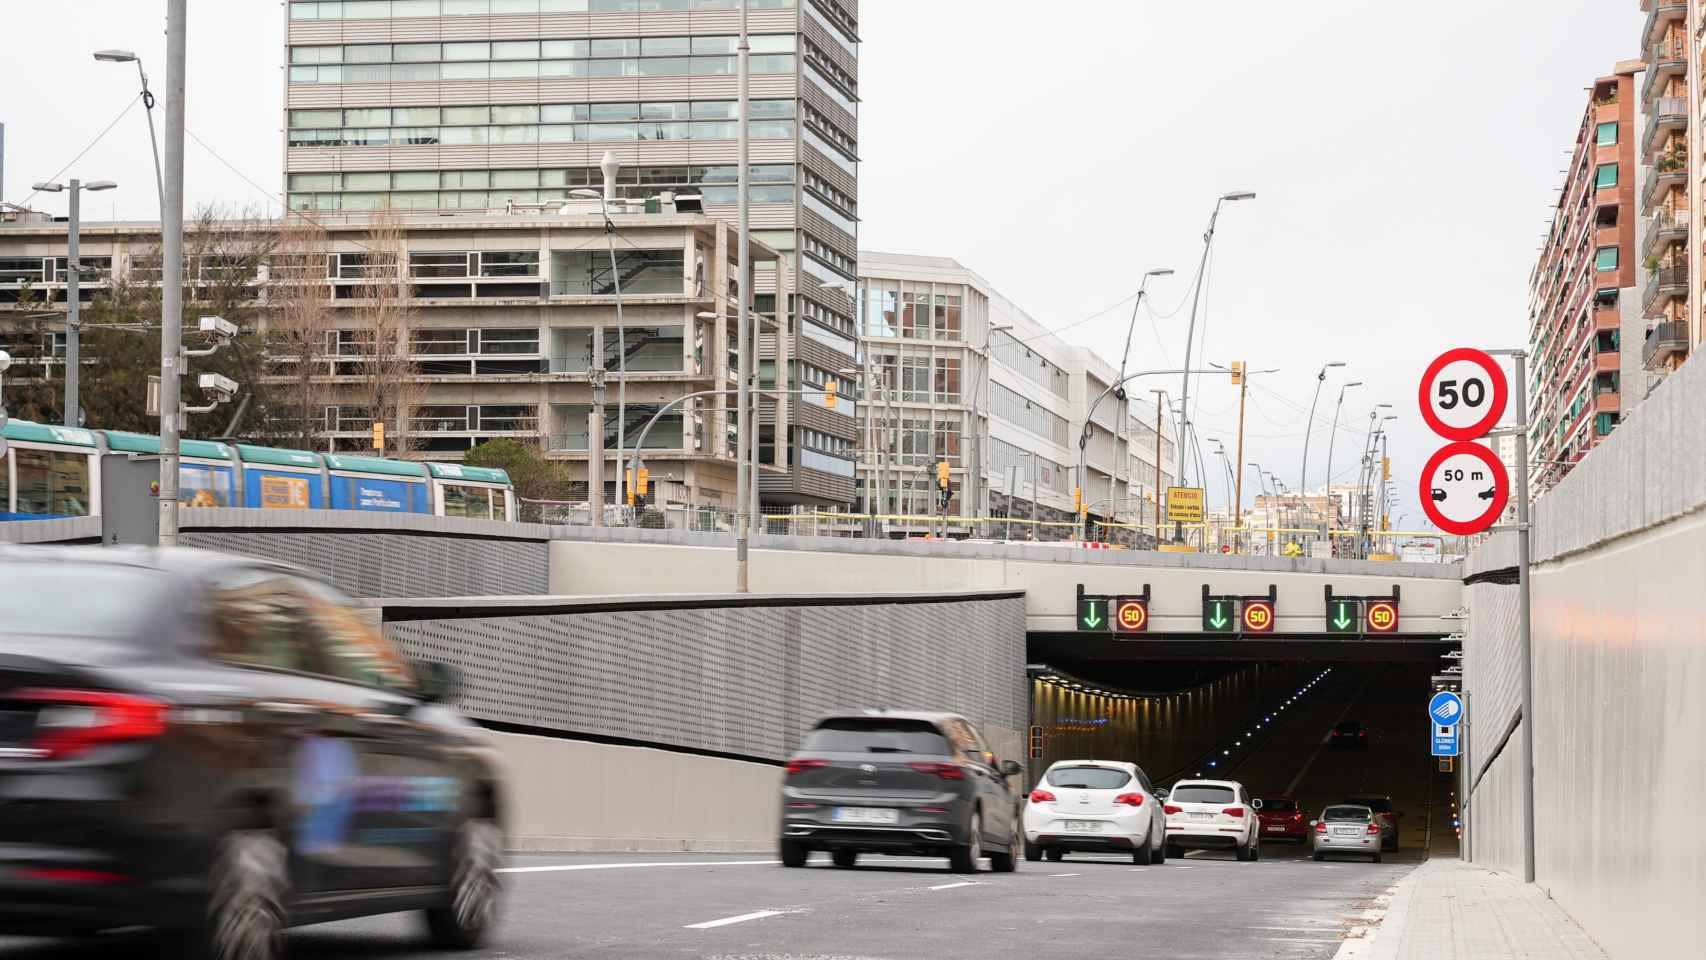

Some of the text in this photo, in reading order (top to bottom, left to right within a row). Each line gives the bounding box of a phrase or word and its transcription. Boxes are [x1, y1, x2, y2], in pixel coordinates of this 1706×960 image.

[1438, 377, 1485, 409] 50
[1444, 469, 1484, 482] 50 m
[1125, 610, 1139, 622] 50
[1251, 610, 1265, 622] 50
[1374, 611, 1389, 623] 50
